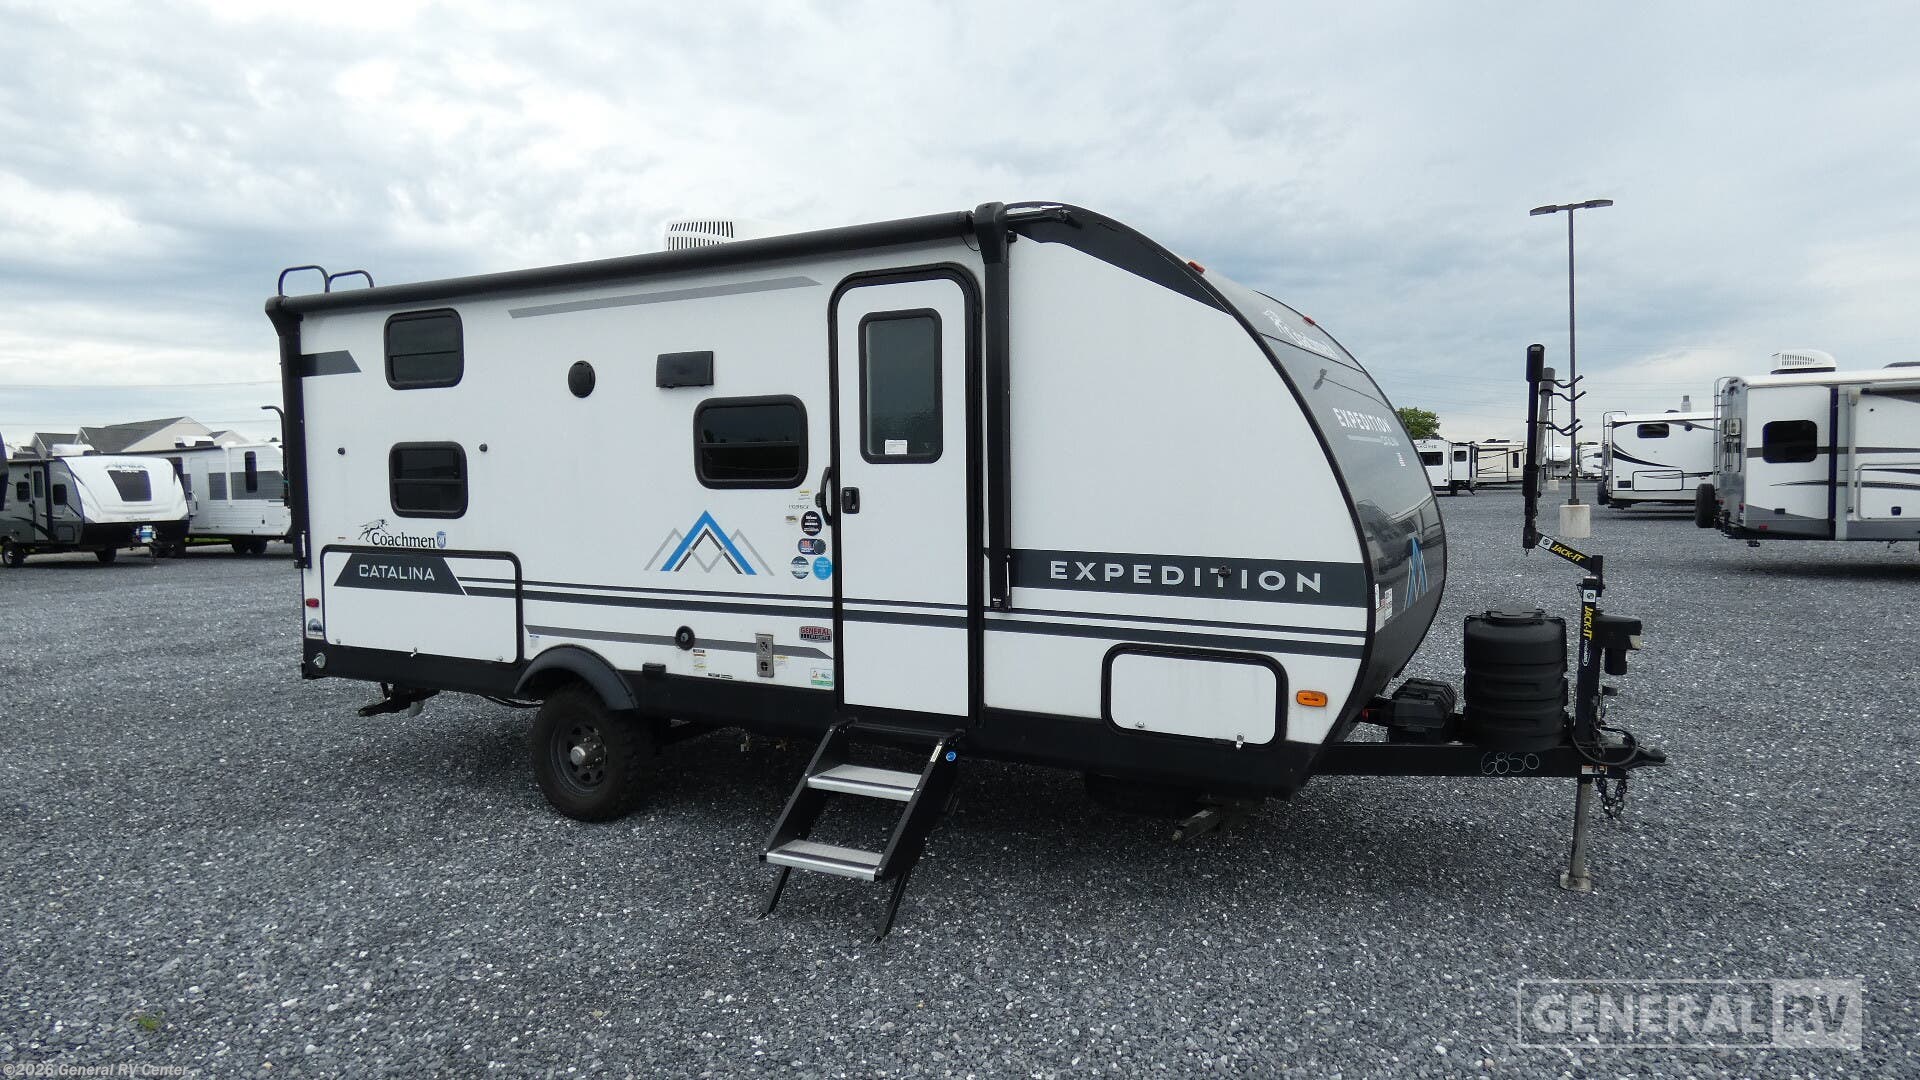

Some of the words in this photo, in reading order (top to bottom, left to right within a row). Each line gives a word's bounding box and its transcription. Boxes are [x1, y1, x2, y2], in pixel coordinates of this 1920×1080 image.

[1332, 407, 1392, 433] EXPEDITION
[371, 532, 436, 549] Coachmen
[1551, 544, 1586, 562] JACK-IT
[359, 564, 435, 581] CATALINA
[1050, 560, 1321, 594] EXPEDITION
[800, 627, 831, 636] GENERAL
[1583, 605, 1594, 641] JACK-IT
[1480, 751, 1540, 775] 6850
